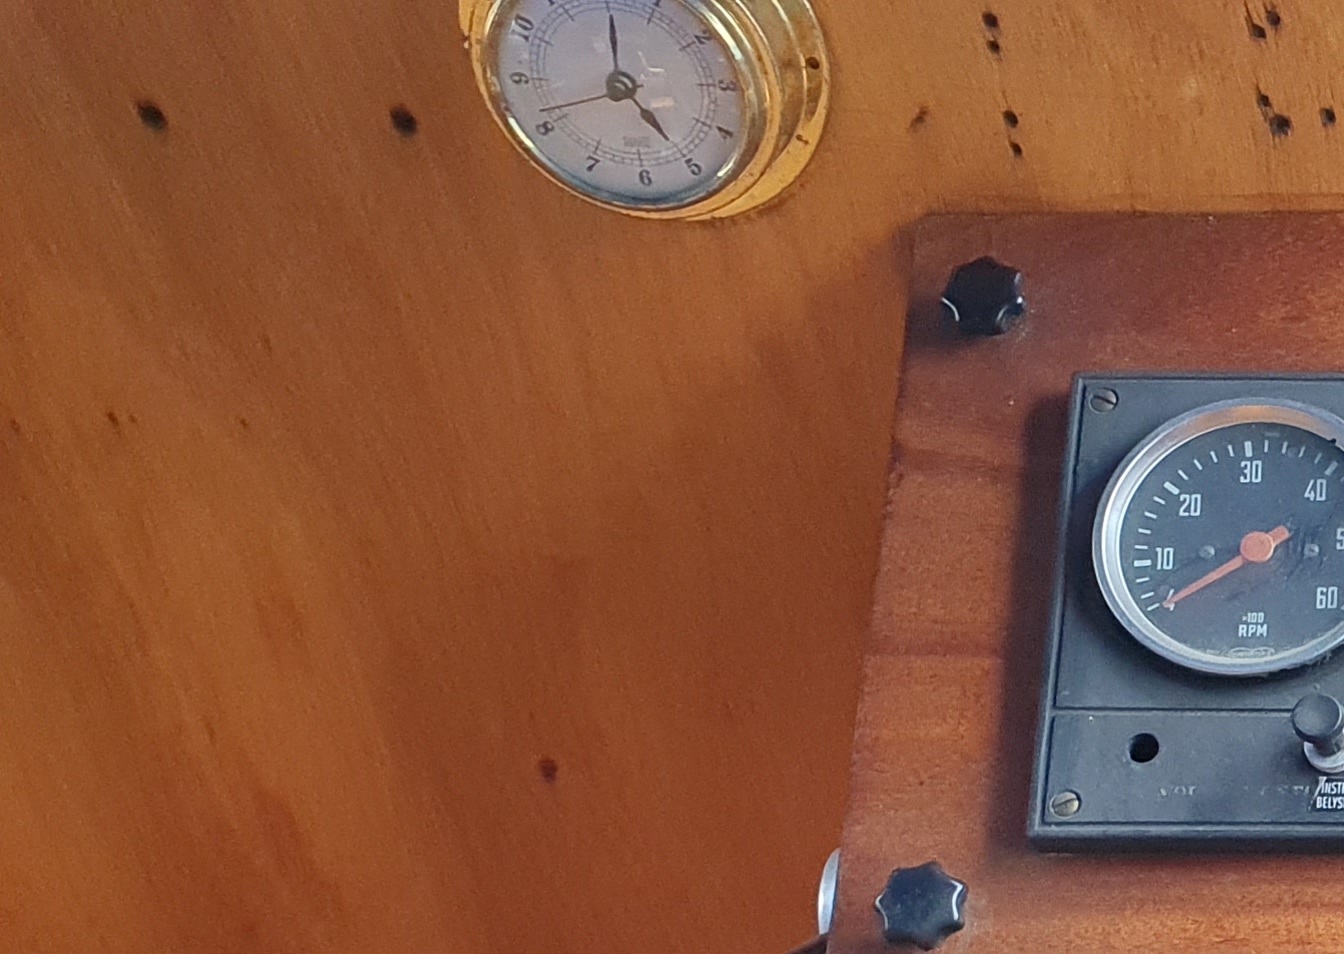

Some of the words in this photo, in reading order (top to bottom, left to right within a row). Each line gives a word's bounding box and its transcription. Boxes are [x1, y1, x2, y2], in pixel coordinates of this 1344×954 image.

[512, 14, 534, 42] 10
[693, 30, 711, 45] 2
[718, 79, 737, 92] 3
[536, 120, 554, 136] 8
[716, 125, 734, 140] 4
[585, 156, 600, 172] 7
[685, 158, 702, 176] 5
[639, 169, 653, 186] 6
[1240, 460, 1262, 484] 30
[1304, 479, 1327, 501] 40
[1179, 494, 1201, 517] 20
[1156, 547, 1174, 570] 10
[1316, 587, 1338, 609] 60
[1238, 624, 1268, 638] RPM
